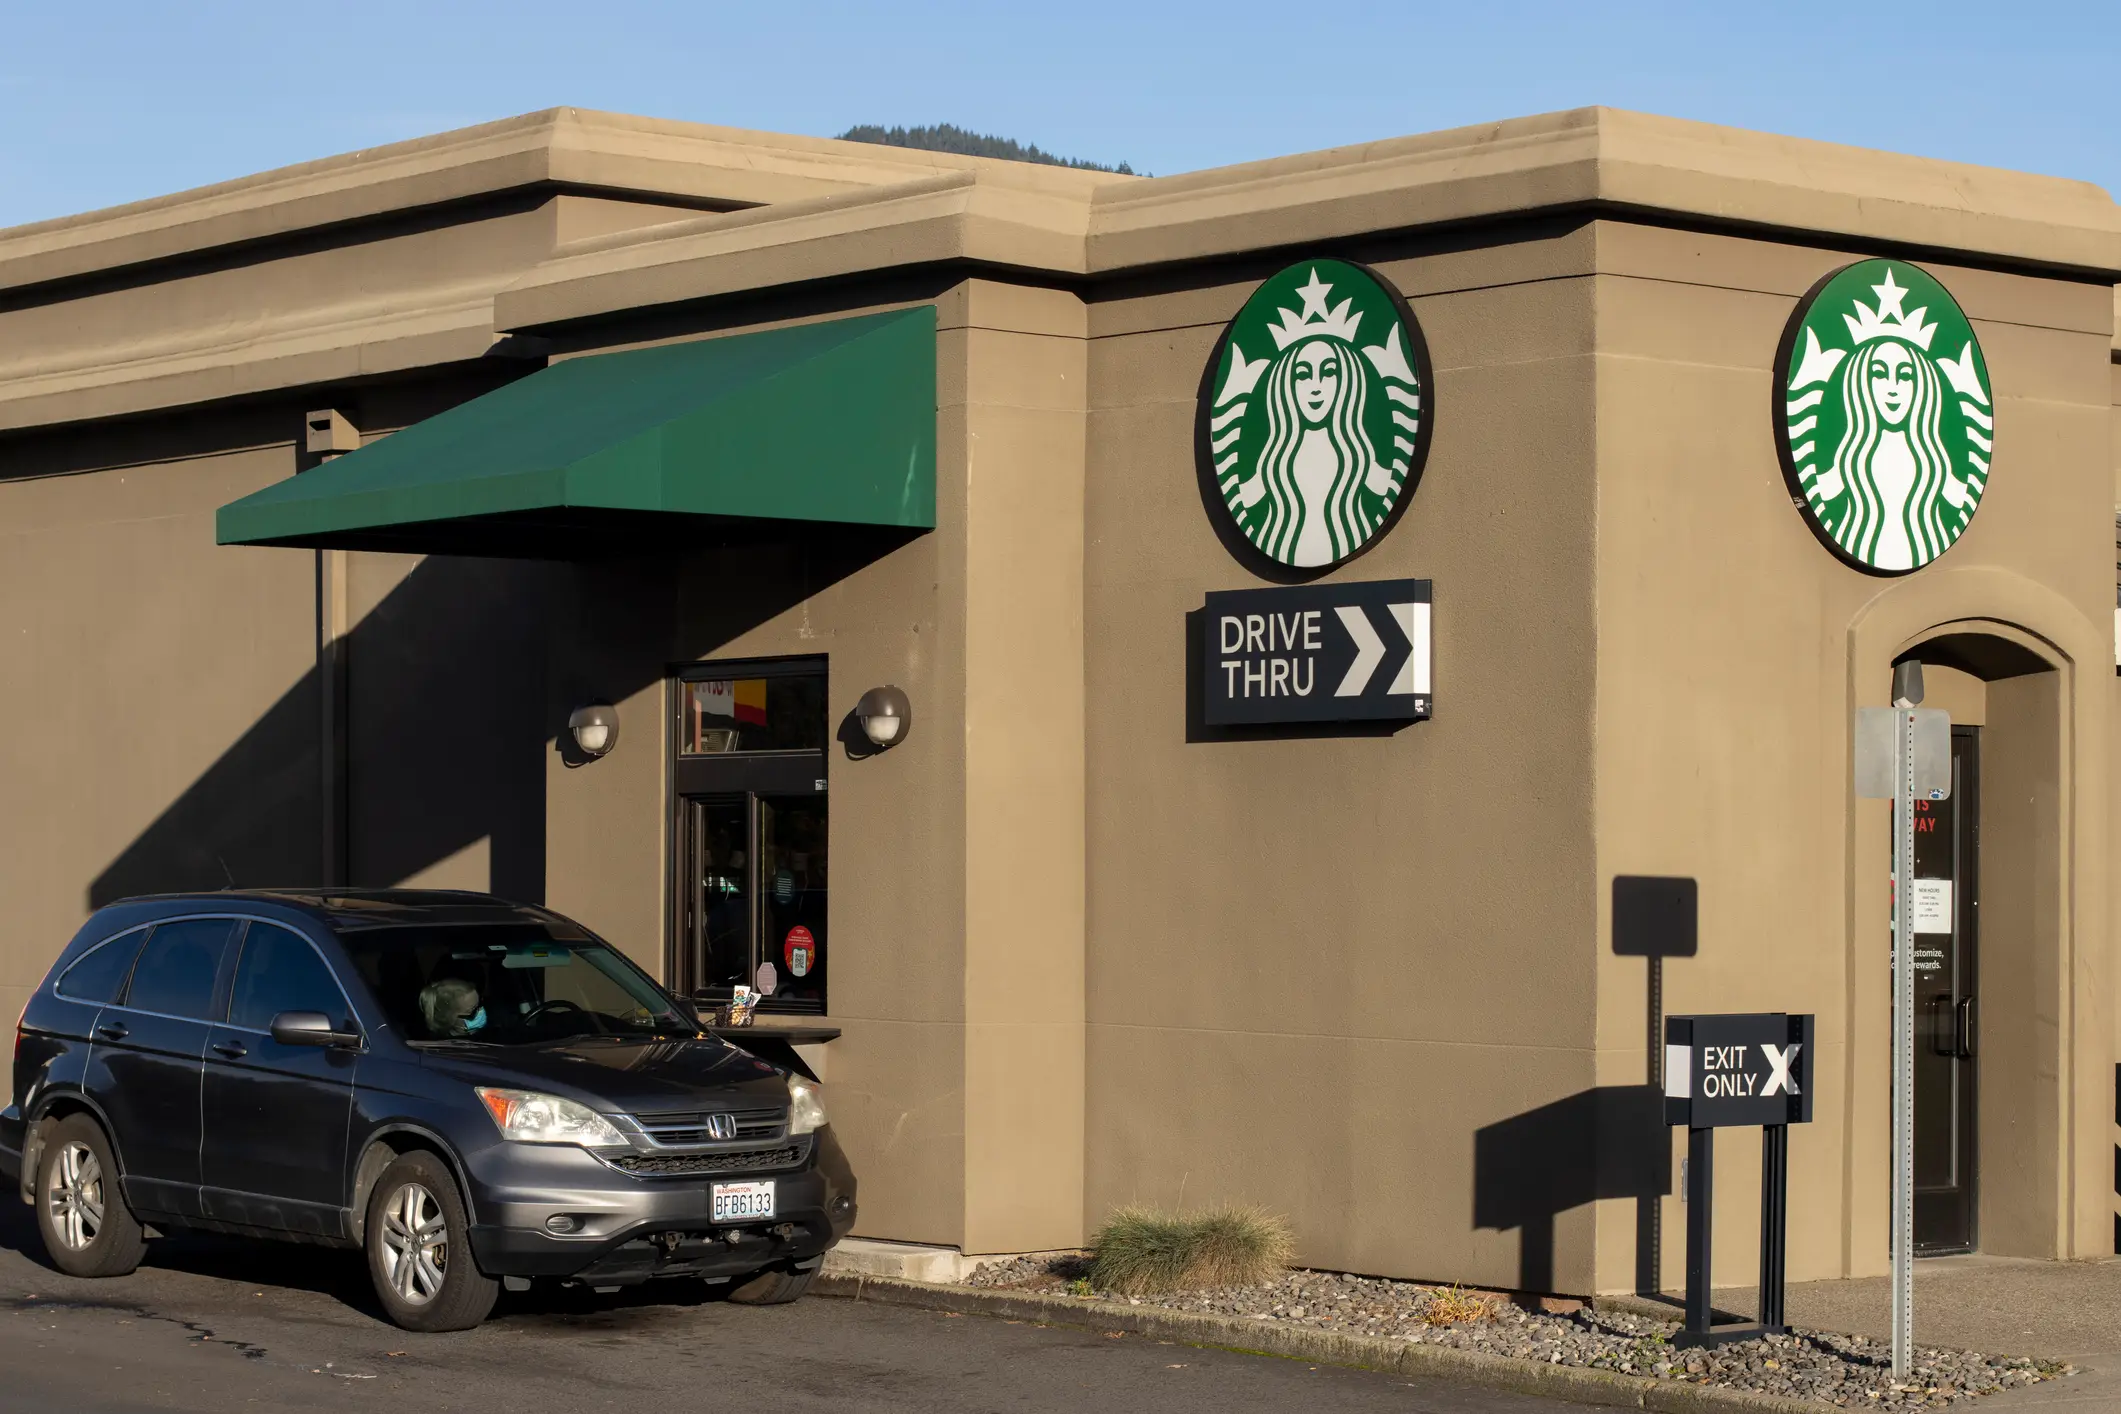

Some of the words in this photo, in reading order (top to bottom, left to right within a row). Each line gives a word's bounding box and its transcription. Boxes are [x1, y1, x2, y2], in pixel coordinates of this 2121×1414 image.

[1221, 611, 1322, 654] DRIVE
[1221, 657, 1314, 699] THRU
[1913, 948, 1944, 960] ustomize,
[1704, 1046, 1747, 1070] EXIT
[1703, 1072, 1758, 1098] ONLY
[716, 1187, 752, 1195] WASHINGTON
[716, 1193, 771, 1216] BFB6133
